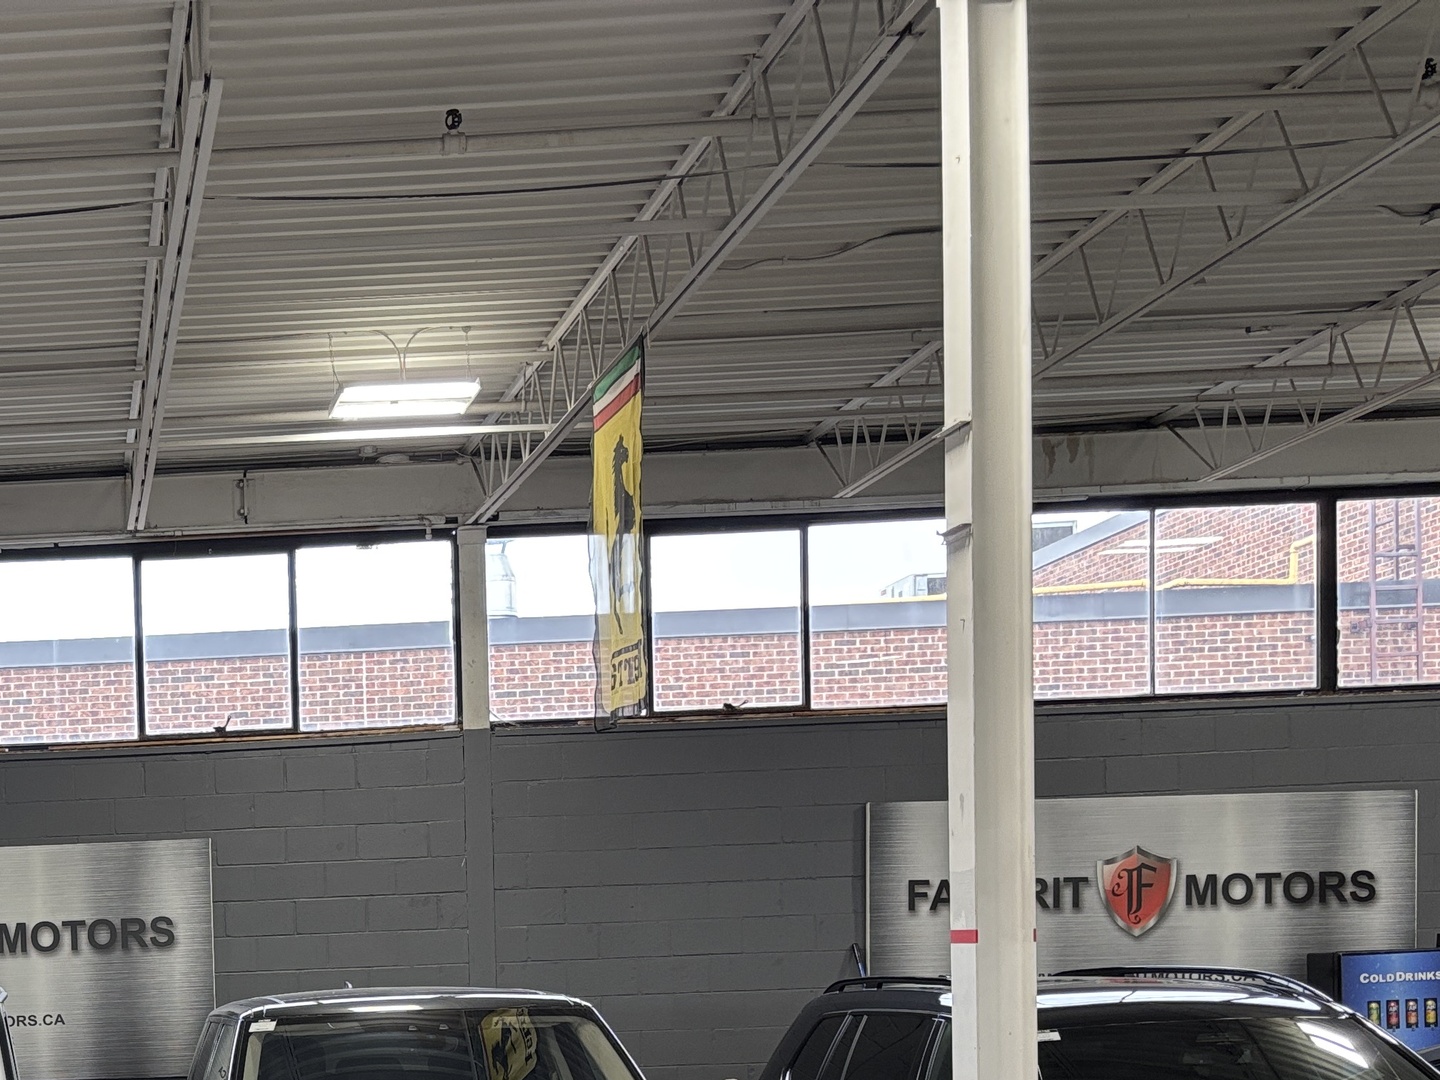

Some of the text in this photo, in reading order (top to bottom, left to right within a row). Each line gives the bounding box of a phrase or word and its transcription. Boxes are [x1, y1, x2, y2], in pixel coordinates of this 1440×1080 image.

[907, 875, 1089, 912] FARIT
[1185, 870, 1377, 907] MOTORS
[1359, 973, 1395, 984] COLD
